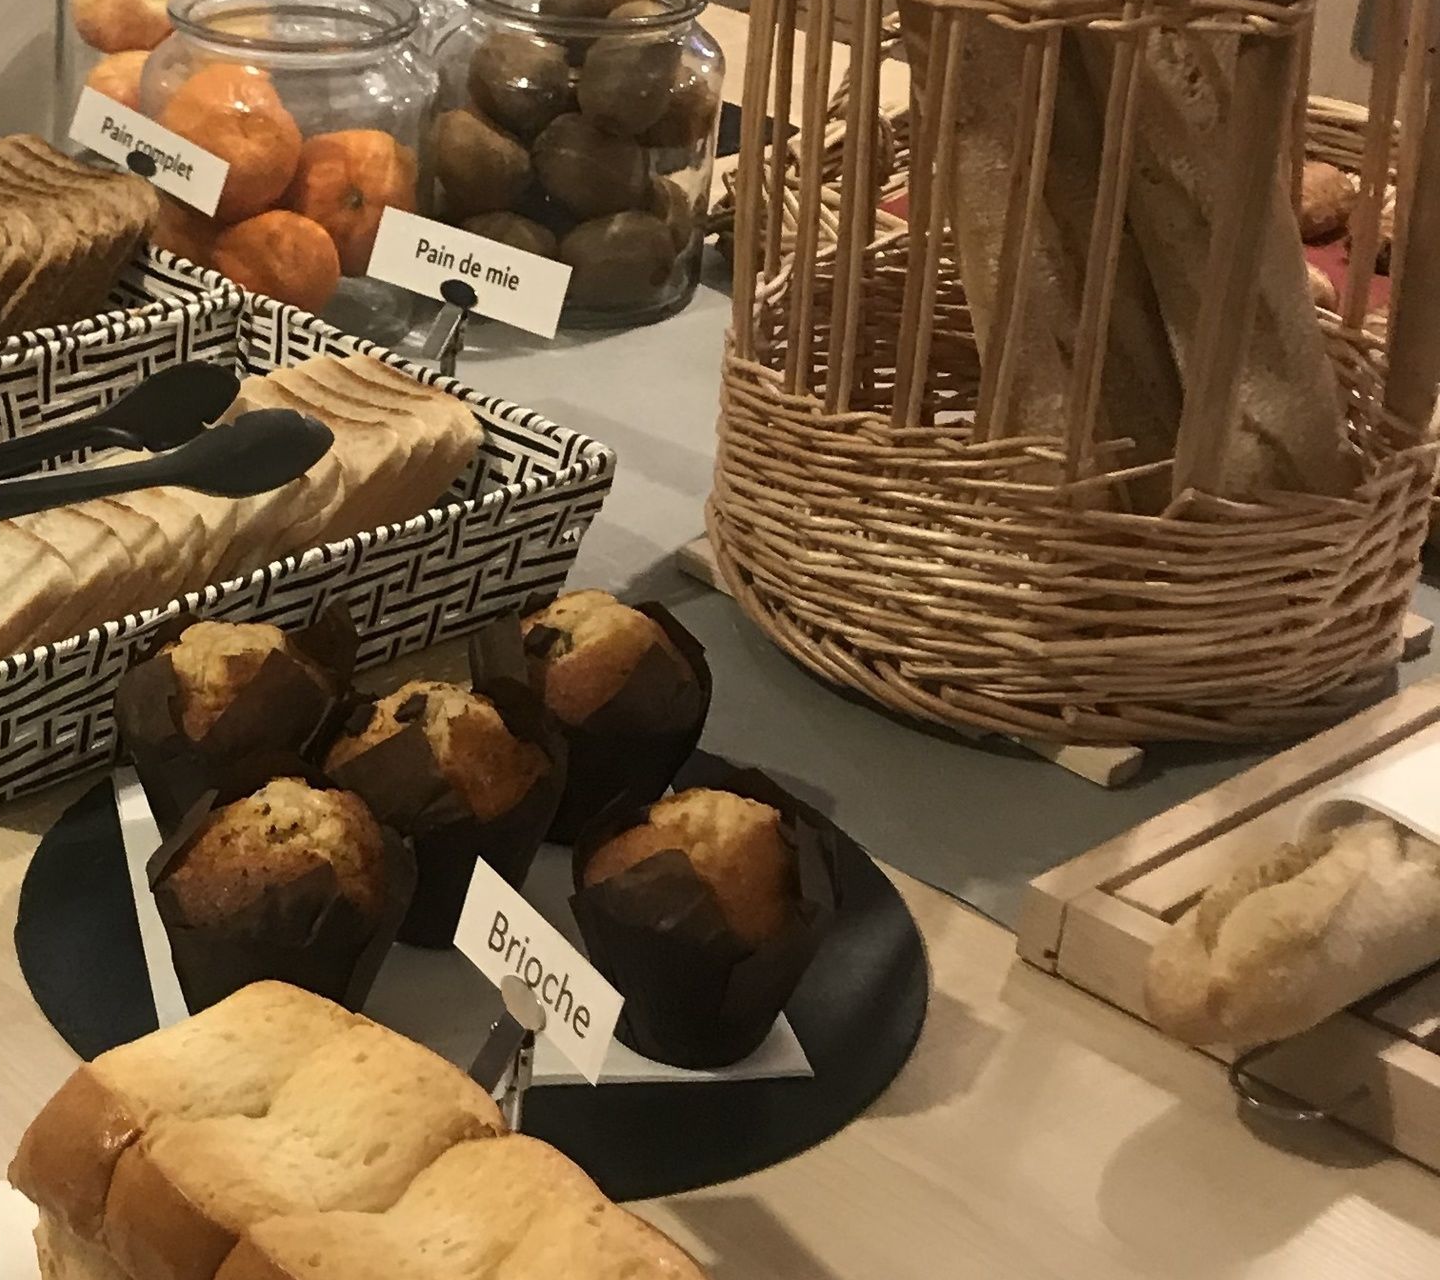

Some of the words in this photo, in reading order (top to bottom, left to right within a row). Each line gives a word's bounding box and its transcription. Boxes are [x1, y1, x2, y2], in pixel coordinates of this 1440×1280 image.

[101, 116, 133, 148] Pain
[415, 238, 455, 269] Pain
[458, 252, 482, 278] de
[485, 265, 520, 291] mie
[488, 910, 591, 1039] Brioche
